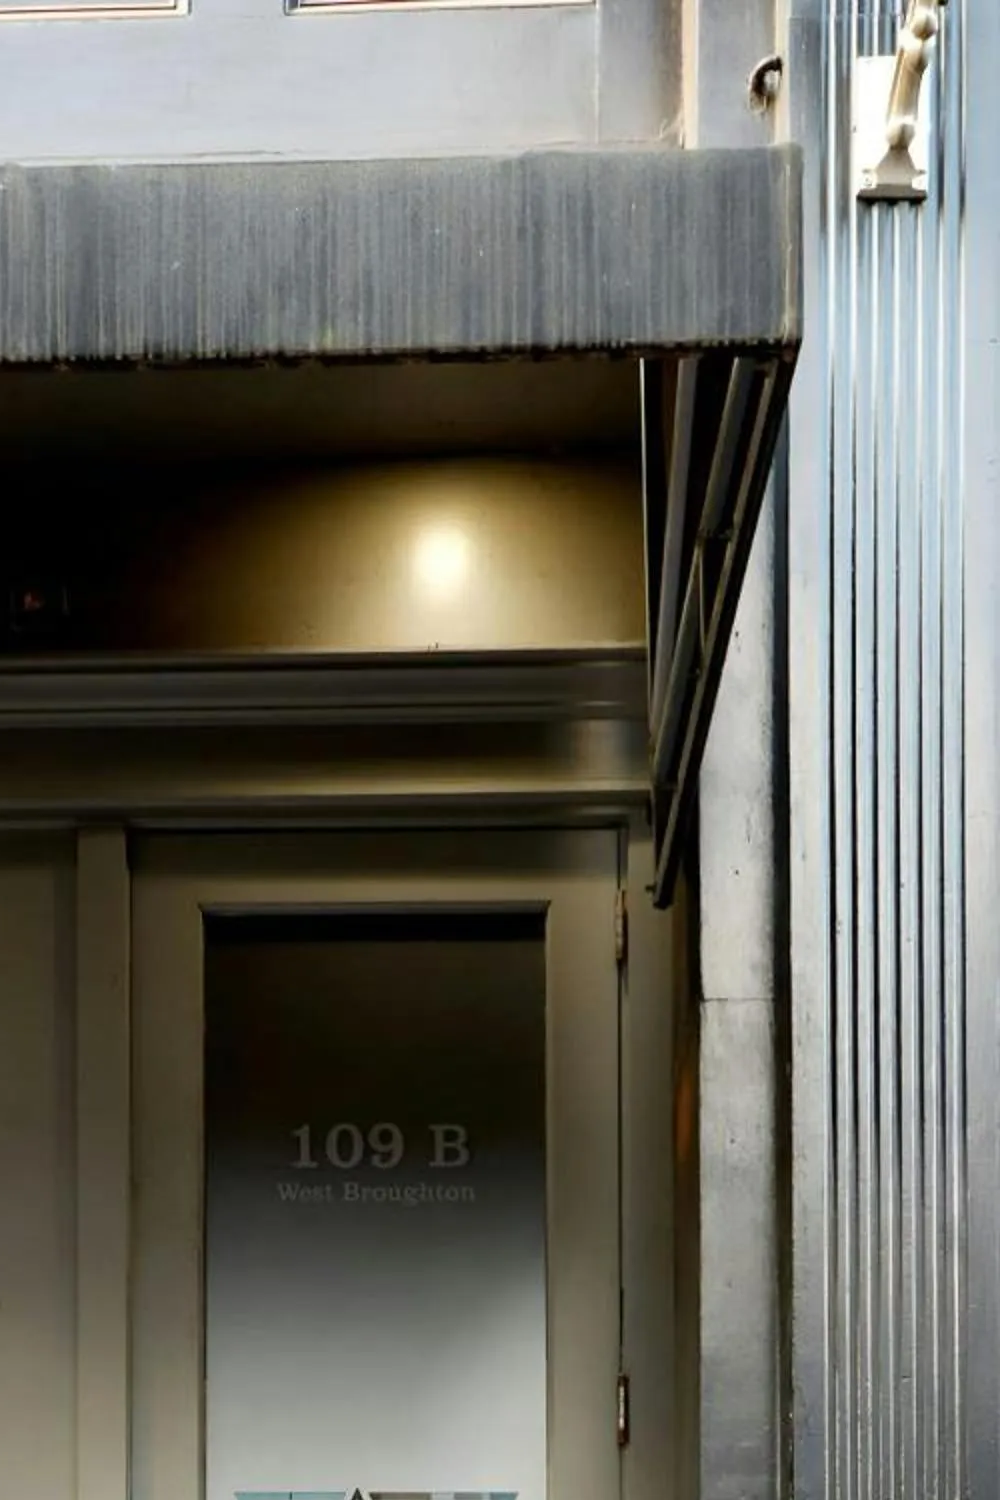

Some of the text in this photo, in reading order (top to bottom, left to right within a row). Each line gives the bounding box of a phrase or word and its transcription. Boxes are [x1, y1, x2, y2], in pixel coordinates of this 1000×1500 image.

[290, 1122, 470, 1169] 109 B
[276, 1182, 476, 1207] West Broughton
